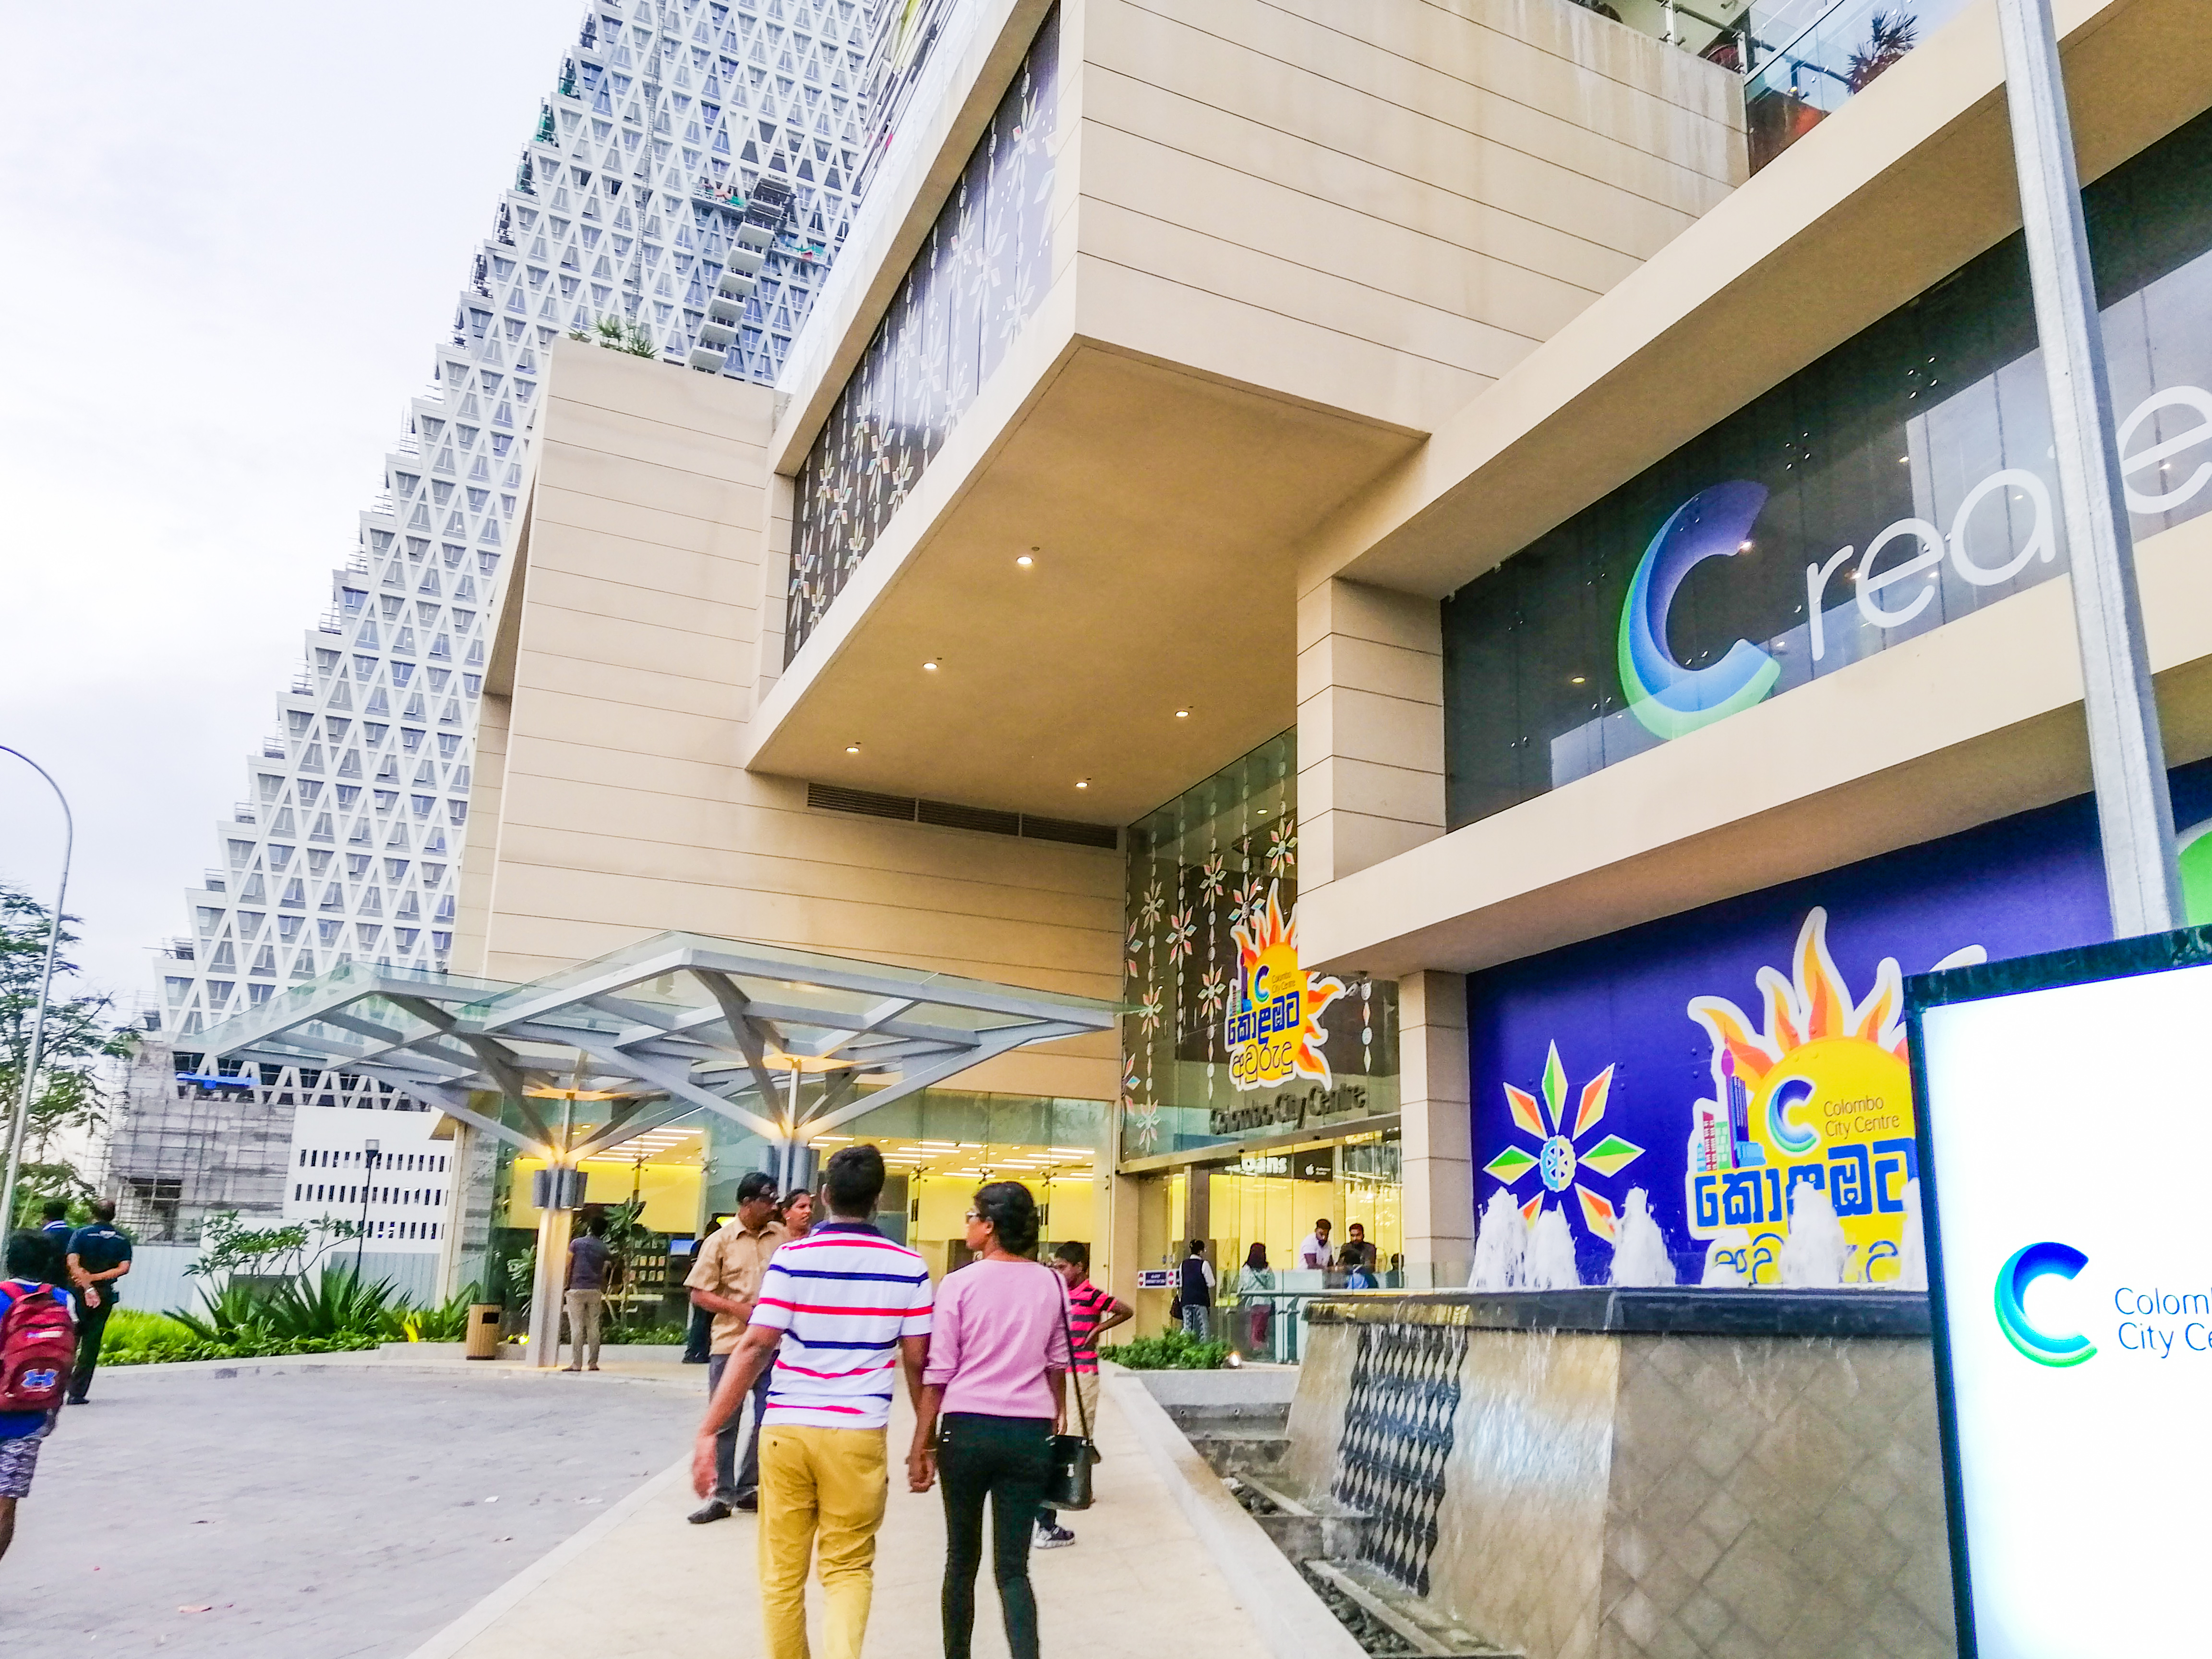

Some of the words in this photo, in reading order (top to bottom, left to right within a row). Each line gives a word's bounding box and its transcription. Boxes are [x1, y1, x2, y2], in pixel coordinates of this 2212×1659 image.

[1618, 385, 2212, 740] Creae
[1824, 1094, 1884, 1117] Colombo
[1826, 1119, 1851, 1140] City
[1854, 1114, 1900, 1132] Centre
[2115, 1287, 2212, 1315] Colom
[2118, 1322, 2174, 1358] City
